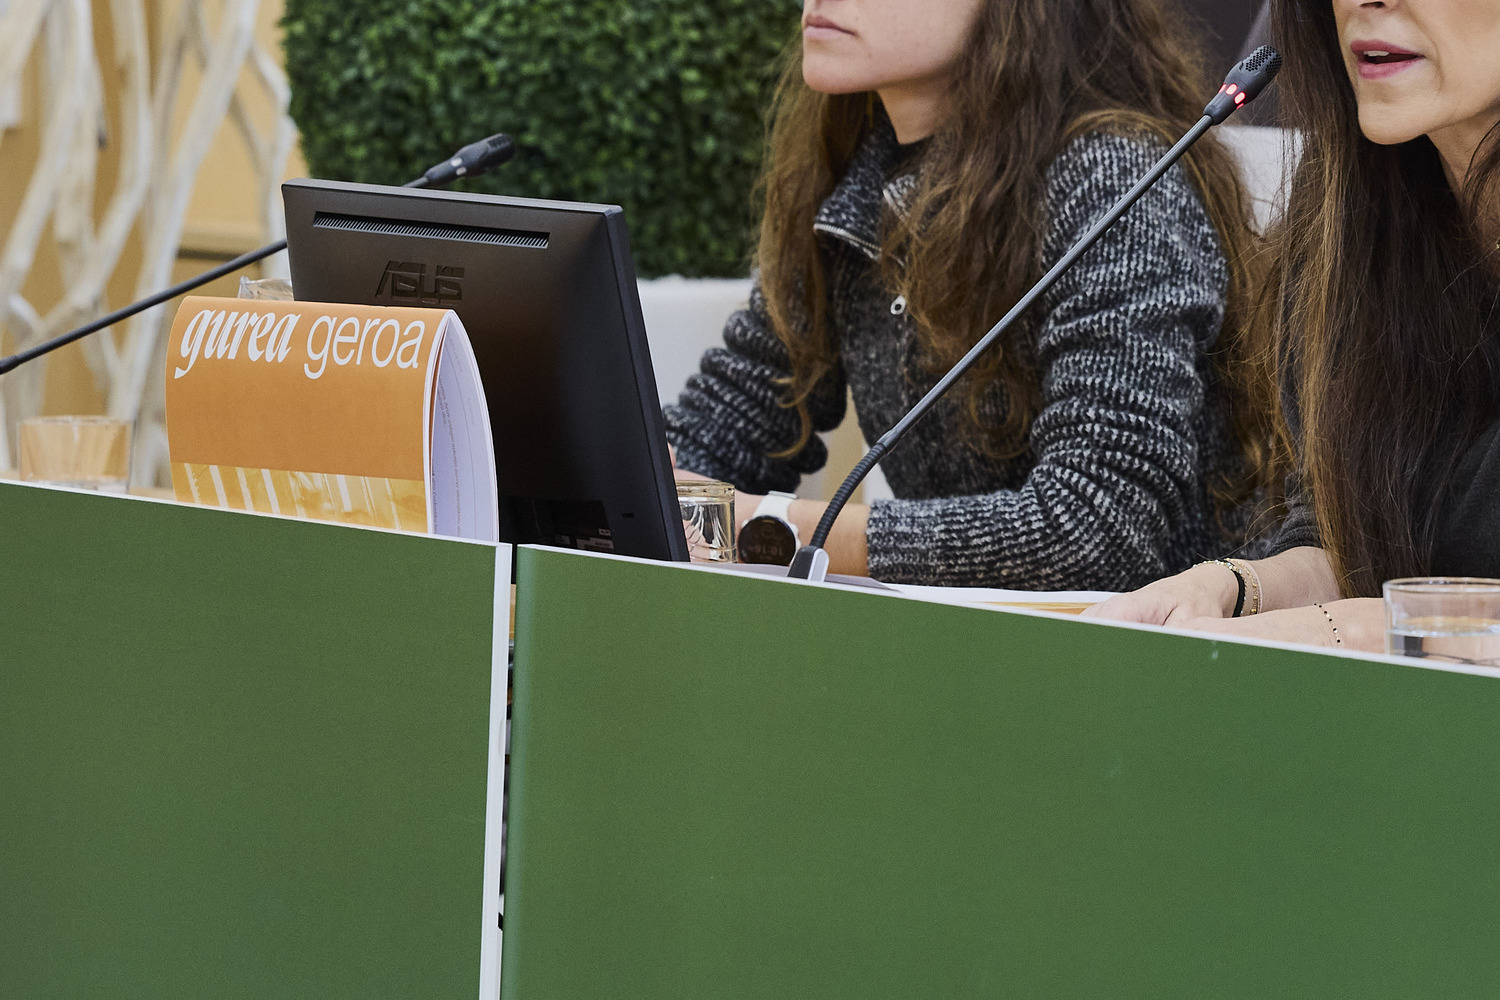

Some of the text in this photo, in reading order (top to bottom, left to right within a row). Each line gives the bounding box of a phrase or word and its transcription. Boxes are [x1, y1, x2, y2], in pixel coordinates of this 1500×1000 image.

[375, 260, 465, 304] ASUS
[174, 305, 301, 379] gurea
[304, 310, 427, 379] geroa
